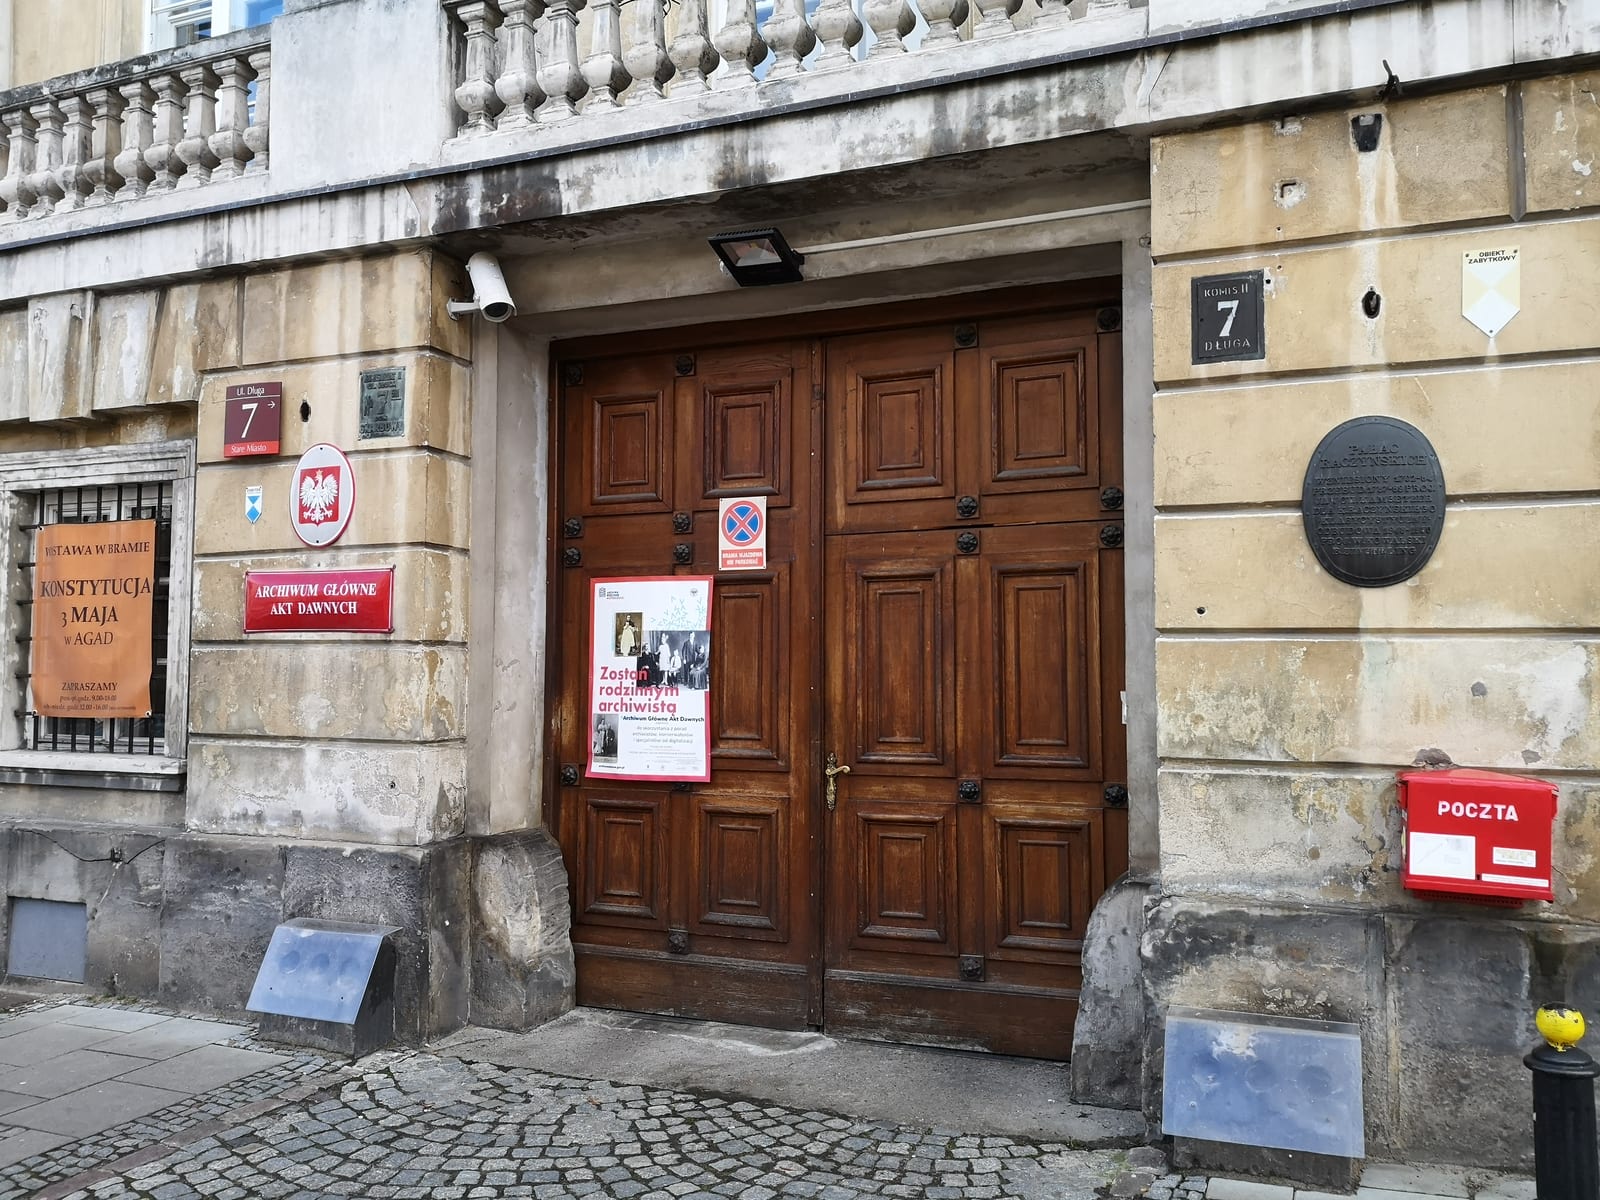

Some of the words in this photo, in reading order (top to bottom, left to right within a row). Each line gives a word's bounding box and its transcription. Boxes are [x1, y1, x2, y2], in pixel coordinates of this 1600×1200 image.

[1468, 255, 1516, 264] ZABYTKOWY
[1479, 250, 1505, 258] OBIEKT
[1217, 300, 1239, 337] 7
[1204, 338, 1251, 351] DŁUGA
[247, 386, 265, 398] Długa
[241, 403, 258, 438] 7
[231, 444, 246, 454] Stare
[246, 443, 267, 453] Miasto
[95, 544, 106, 554] W
[108, 542, 150, 553] BRAMIE
[40, 577, 151, 598] KONSTYTUCJA
[255, 583, 319, 598] ARCHIWUM
[323, 580, 377, 596] GŁÓWNE
[270, 602, 293, 615] AKT
[298, 601, 357, 614] DAWNYCH
[61, 612, 67, 627] 3
[71, 606, 118, 626] MAJA
[74, 631, 114, 645] AGAD
[600, 665, 648, 680] Zostań
[61, 682, 118, 691] ZAPRASZAMY
[599, 681, 680, 701] rodzinnym
[598, 697, 677, 716] archiwistą
[1437, 800, 1519, 821] POCZTA
